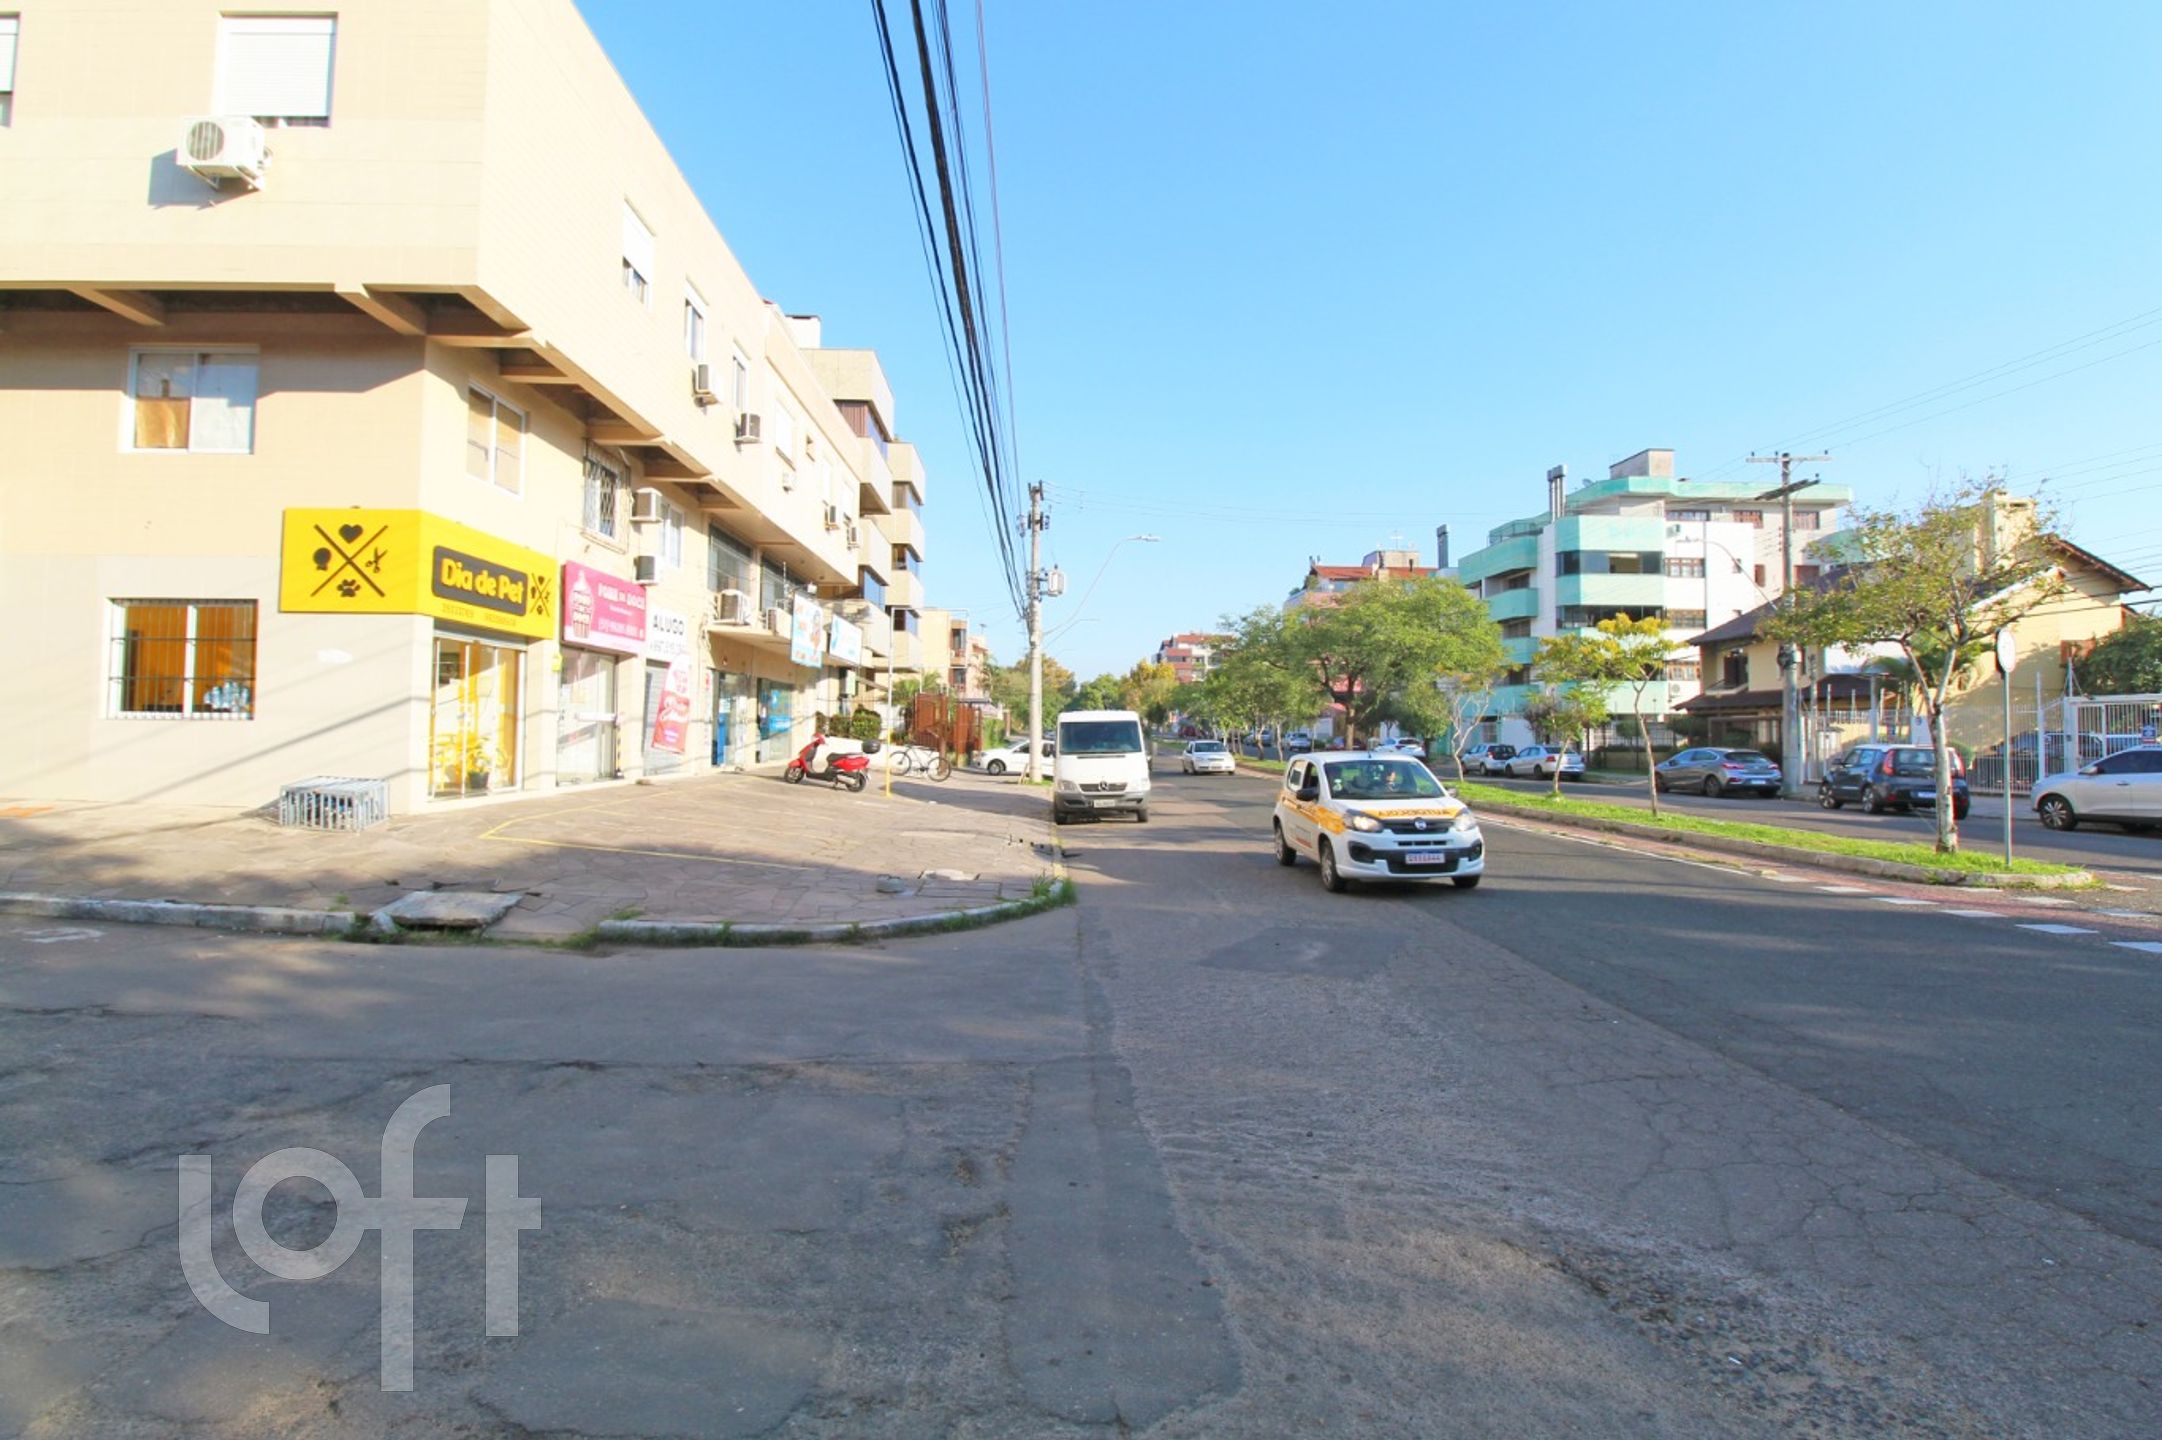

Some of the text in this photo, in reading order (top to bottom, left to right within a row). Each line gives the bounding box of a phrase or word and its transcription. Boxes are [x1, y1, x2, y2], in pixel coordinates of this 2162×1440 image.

[440, 557, 524, 604] Dia de Pet
